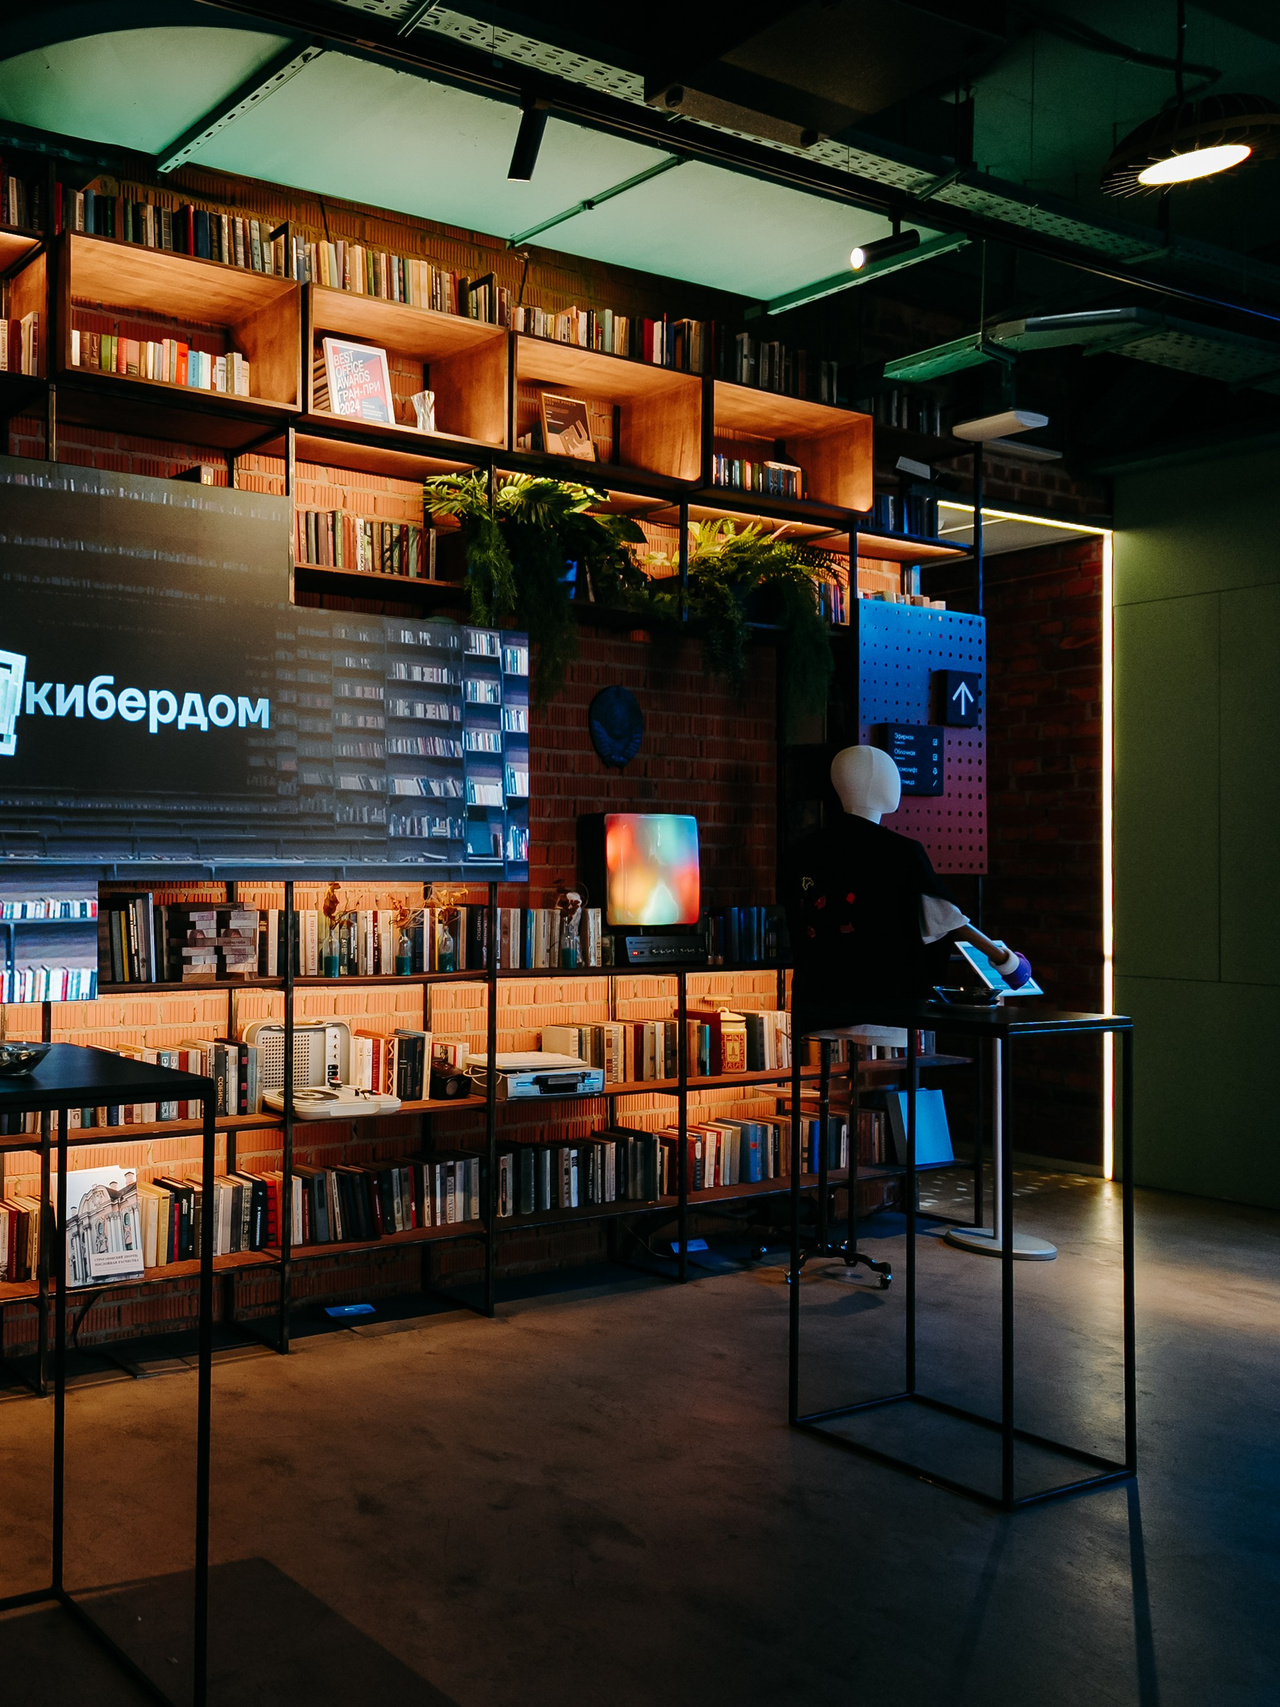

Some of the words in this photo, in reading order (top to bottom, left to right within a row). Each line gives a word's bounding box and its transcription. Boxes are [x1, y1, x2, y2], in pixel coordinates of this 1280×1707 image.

[333, 350, 355, 366] BEST
[335, 360, 365, 378] OFFICE
[337, 371, 371, 391] AWARDS
[338, 380, 381, 402] ГРАН-ПРИ
[340, 399, 361, 416] 2024
[560, 420, 588, 454] RU
[25, 675, 270, 734] кибердом
